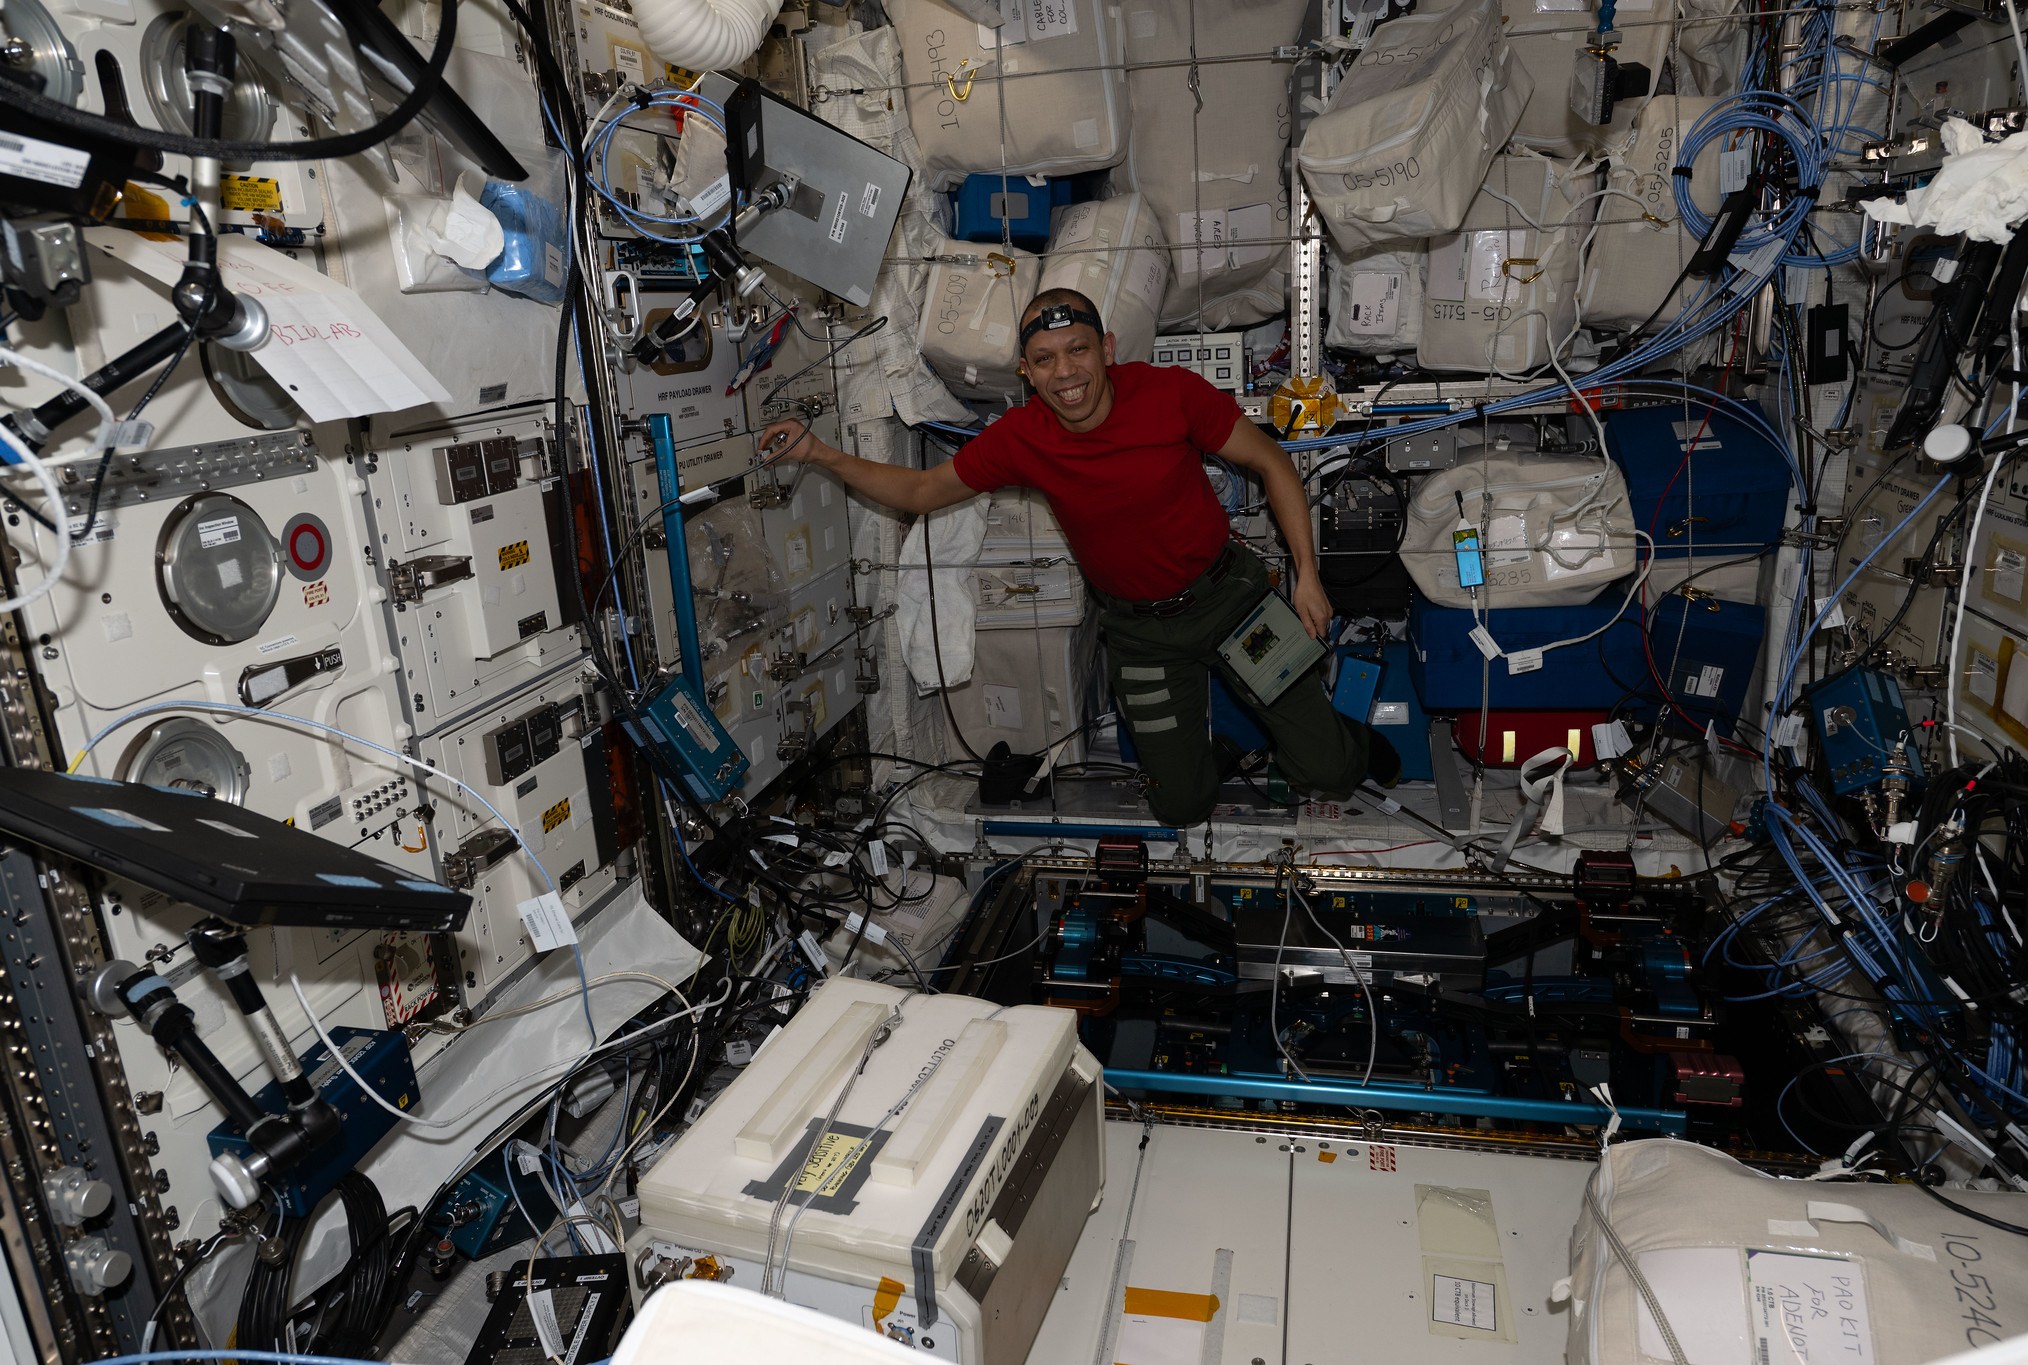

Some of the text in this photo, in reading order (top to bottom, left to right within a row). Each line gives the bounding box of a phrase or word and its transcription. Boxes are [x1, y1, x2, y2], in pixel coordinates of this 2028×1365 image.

[658, 385, 712, 401] HRF PAYLOAD DRAWER
[687, 456, 704, 468] UTILITY
[704, 451, 724, 464] DRAWER
[1900, 487, 1920, 500] DRAWER
[325, 652, 342, 667] PUSH
[405, 987, 434, 1013] RACK POWER
[582, 1300, 599, 1320] SUPPLY
[1767, 1297, 1775, 1310] CTB
[899, 1310, 916, 1318] Power
[1779, 1284, 1808, 1362] ADENOT
[1831, 1276, 1862, 1356] PAO KIT
[574, 1320, 591, 1340] POWER
[563, 1340, 582, 1365] ORTABLE
